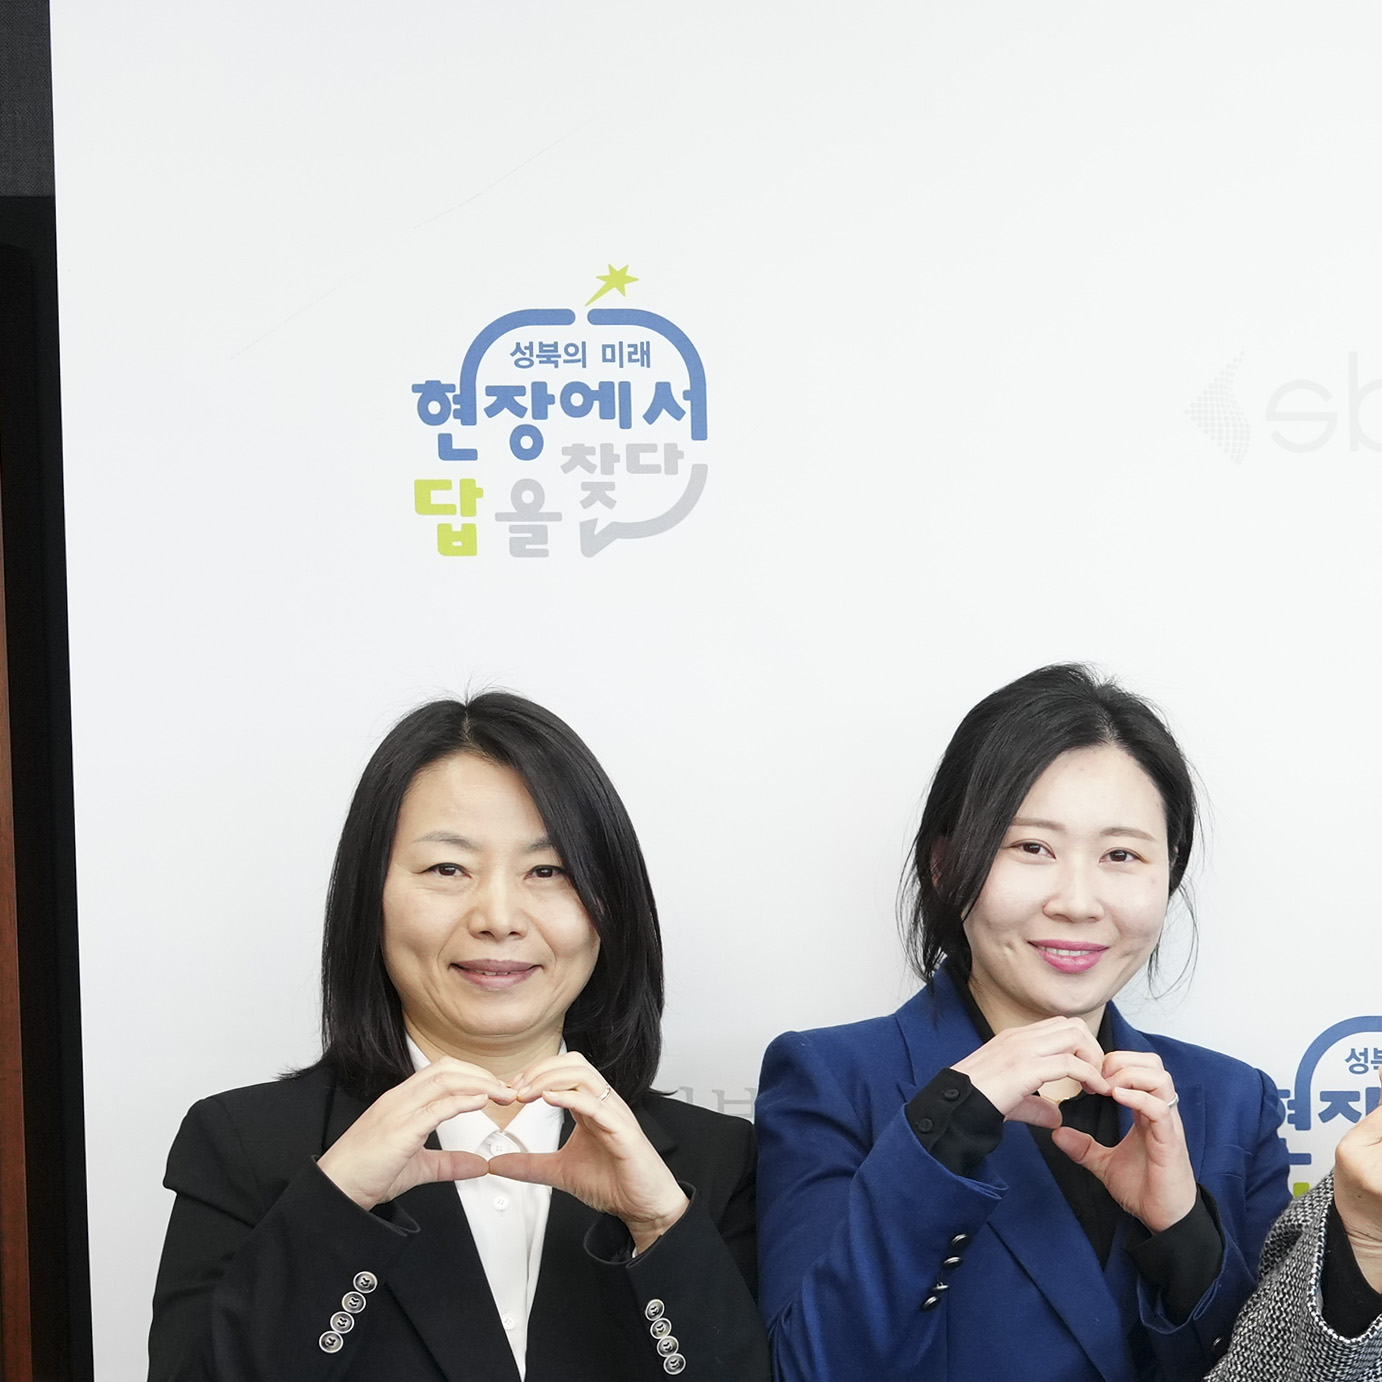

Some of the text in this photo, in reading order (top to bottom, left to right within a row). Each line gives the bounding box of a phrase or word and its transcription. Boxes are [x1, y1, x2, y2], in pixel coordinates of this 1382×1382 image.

[510, 341, 651, 369] 성북의 미래
[411, 380, 707, 461] 현장에서
